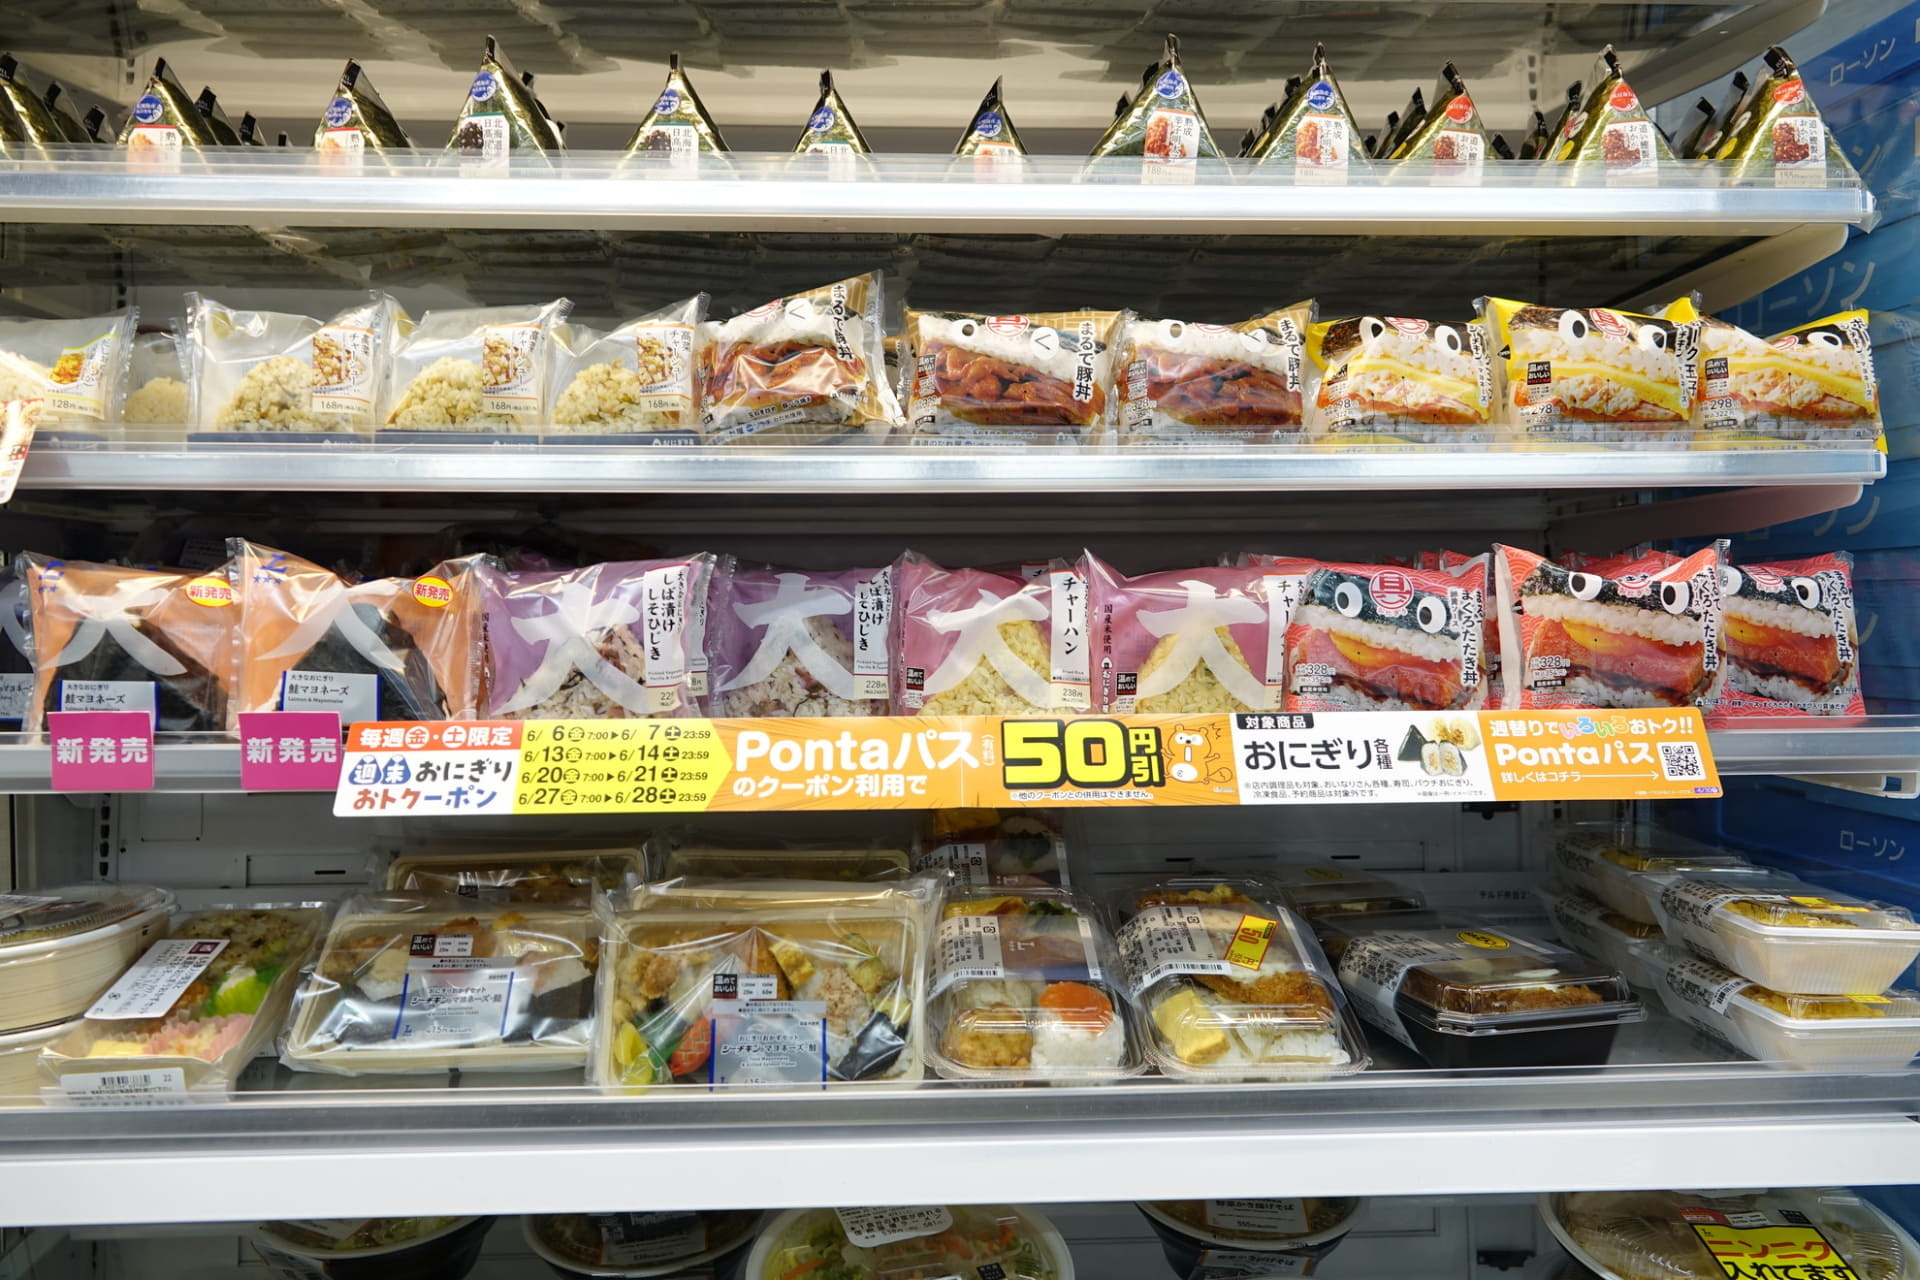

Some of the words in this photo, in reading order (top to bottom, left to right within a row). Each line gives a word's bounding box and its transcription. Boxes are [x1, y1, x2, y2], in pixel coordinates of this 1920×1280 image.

[1829, 37, 1896, 88] ローソン
[1074, 321, 1096, 401] まるで豚丼
[188, 584, 233, 599] 新発売
[414, 584, 450, 602] 新発売
[661, 573, 677, 633] しば漬け
[647, 588, 661, 661] しそひじき
[1063, 576, 1080, 656] チャーハン
[1102, 603, 1113, 655] 国産米使用
[1461, 591, 1478, 685] まぐろたたき丼
[64, 693, 126, 704] 鮭マヨネーズ
[287, 683, 350, 696] 鮭マヨネーズ
[1244, 715, 1308, 729] 対象商品
[56, 736, 149, 764] 新発売
[246, 736, 338, 764] 新発売
[1243, 738, 1372, 771] おにぎり
[1373, 738, 1394, 771] 各種
[415, 756, 513, 783] おにぎり
[1500, 770, 1583, 784] 詳しくはコチラ
[353, 785, 498, 811] おトクーポン
[732, 773, 928, 798] のクーポン利用で
[1839, 828, 1906, 862] ローソン
[1706, 1239, 1832, 1262] ニンニク
